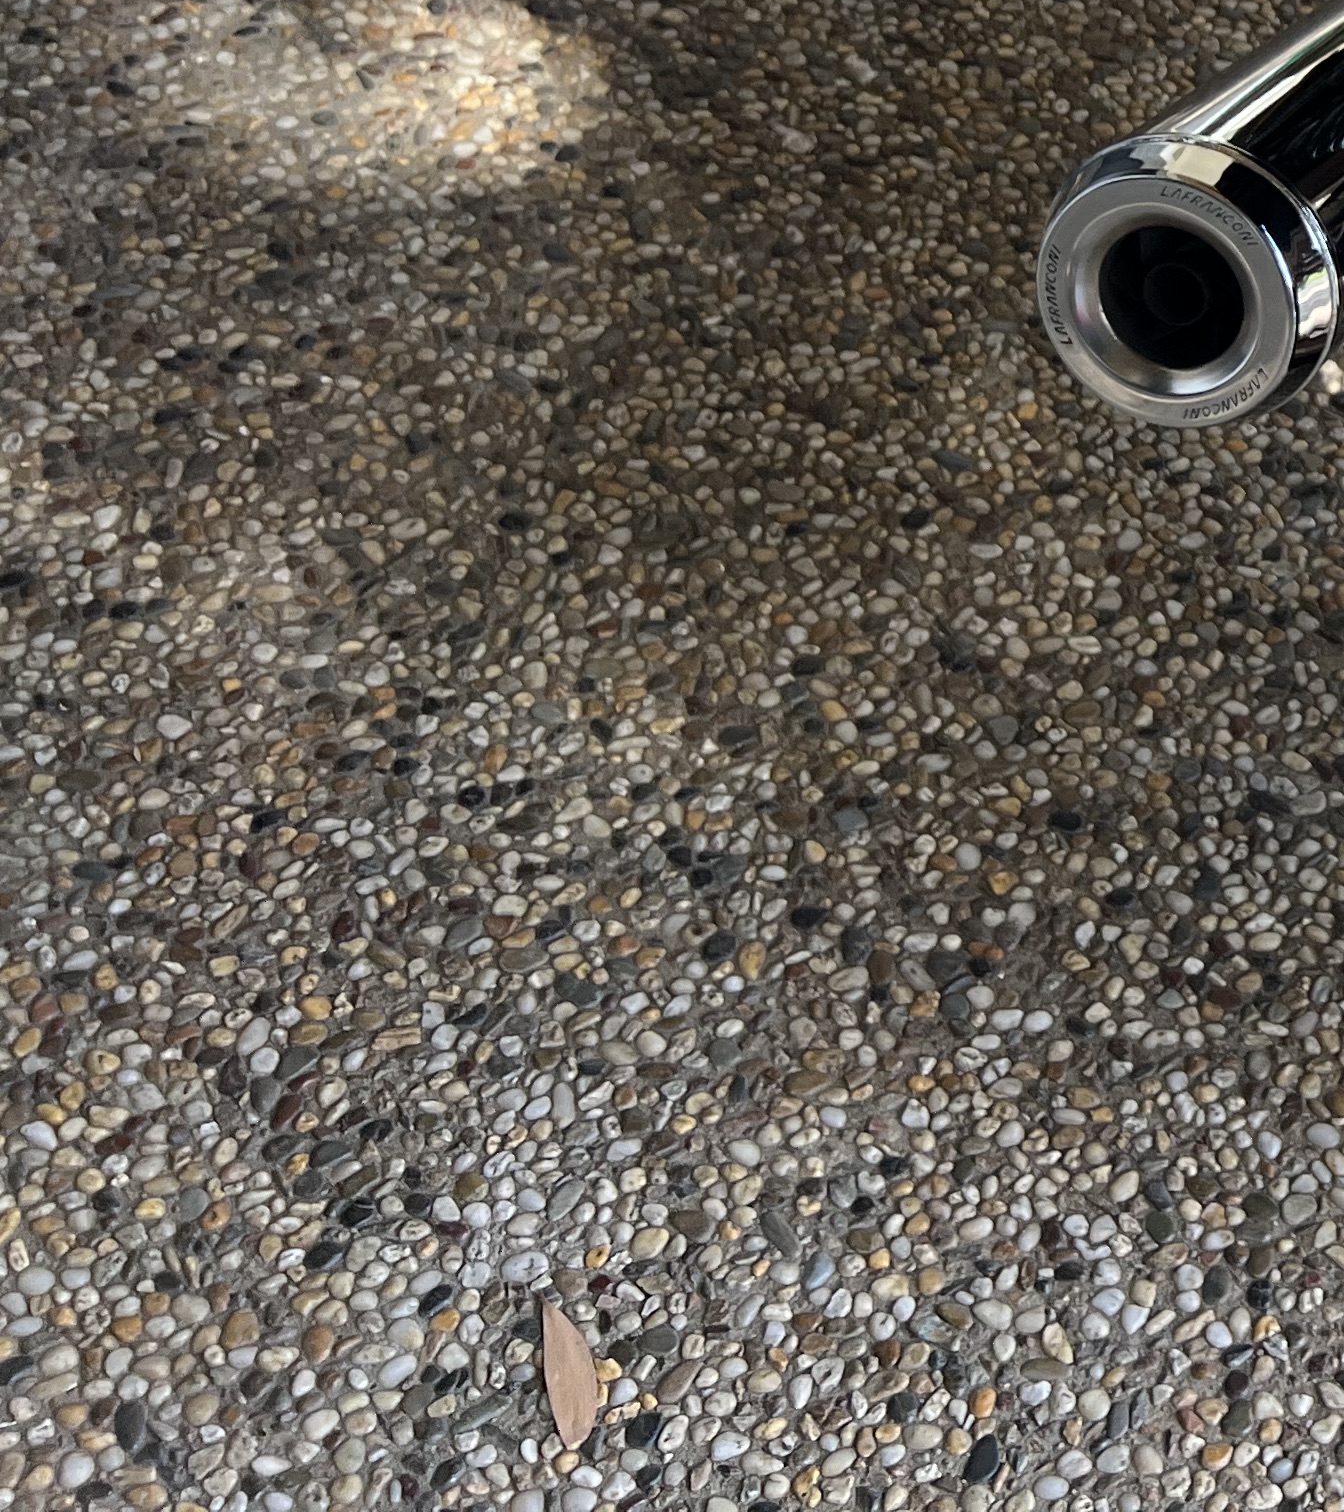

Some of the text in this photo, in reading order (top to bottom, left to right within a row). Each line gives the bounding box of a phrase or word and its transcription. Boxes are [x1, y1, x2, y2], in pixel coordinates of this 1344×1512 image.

[1160, 185, 1261, 248] LAFRANCONI
[1044, 243, 1074, 347] LAFRANCONI
[1182, 367, 1270, 421] LAFRANCONI
